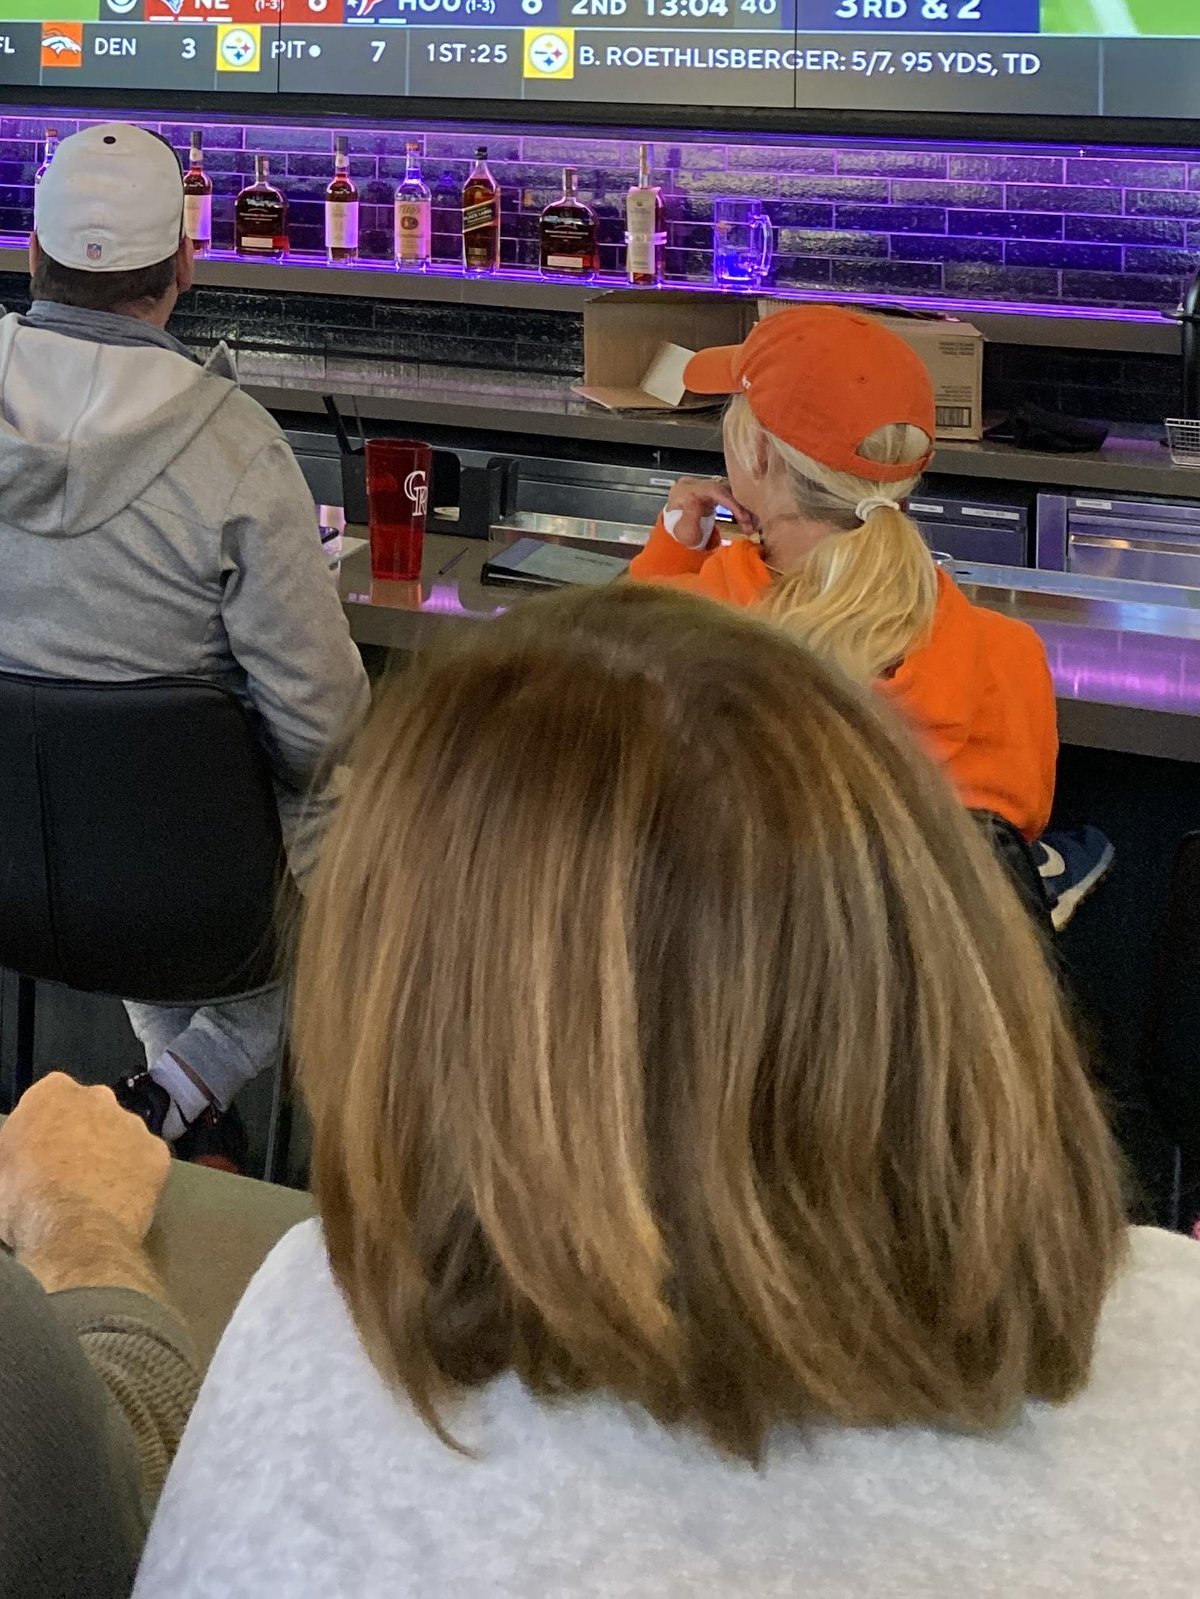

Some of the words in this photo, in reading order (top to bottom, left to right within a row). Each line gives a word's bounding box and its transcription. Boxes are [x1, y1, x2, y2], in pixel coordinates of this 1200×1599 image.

[94, 37, 137, 56] DEN
[181, 37, 197, 60] 3
[370, 40, 386, 63] 7
[578, 45, 600, 67] B.
[606, 46, 847, 72] ROETHLISBERGER:
[851, 50, 896, 77] 5/7,
[900, 51, 934, 73] 95
[936, 52, 999, 77] YDS,
[1002, 53, 1042, 74] TD
